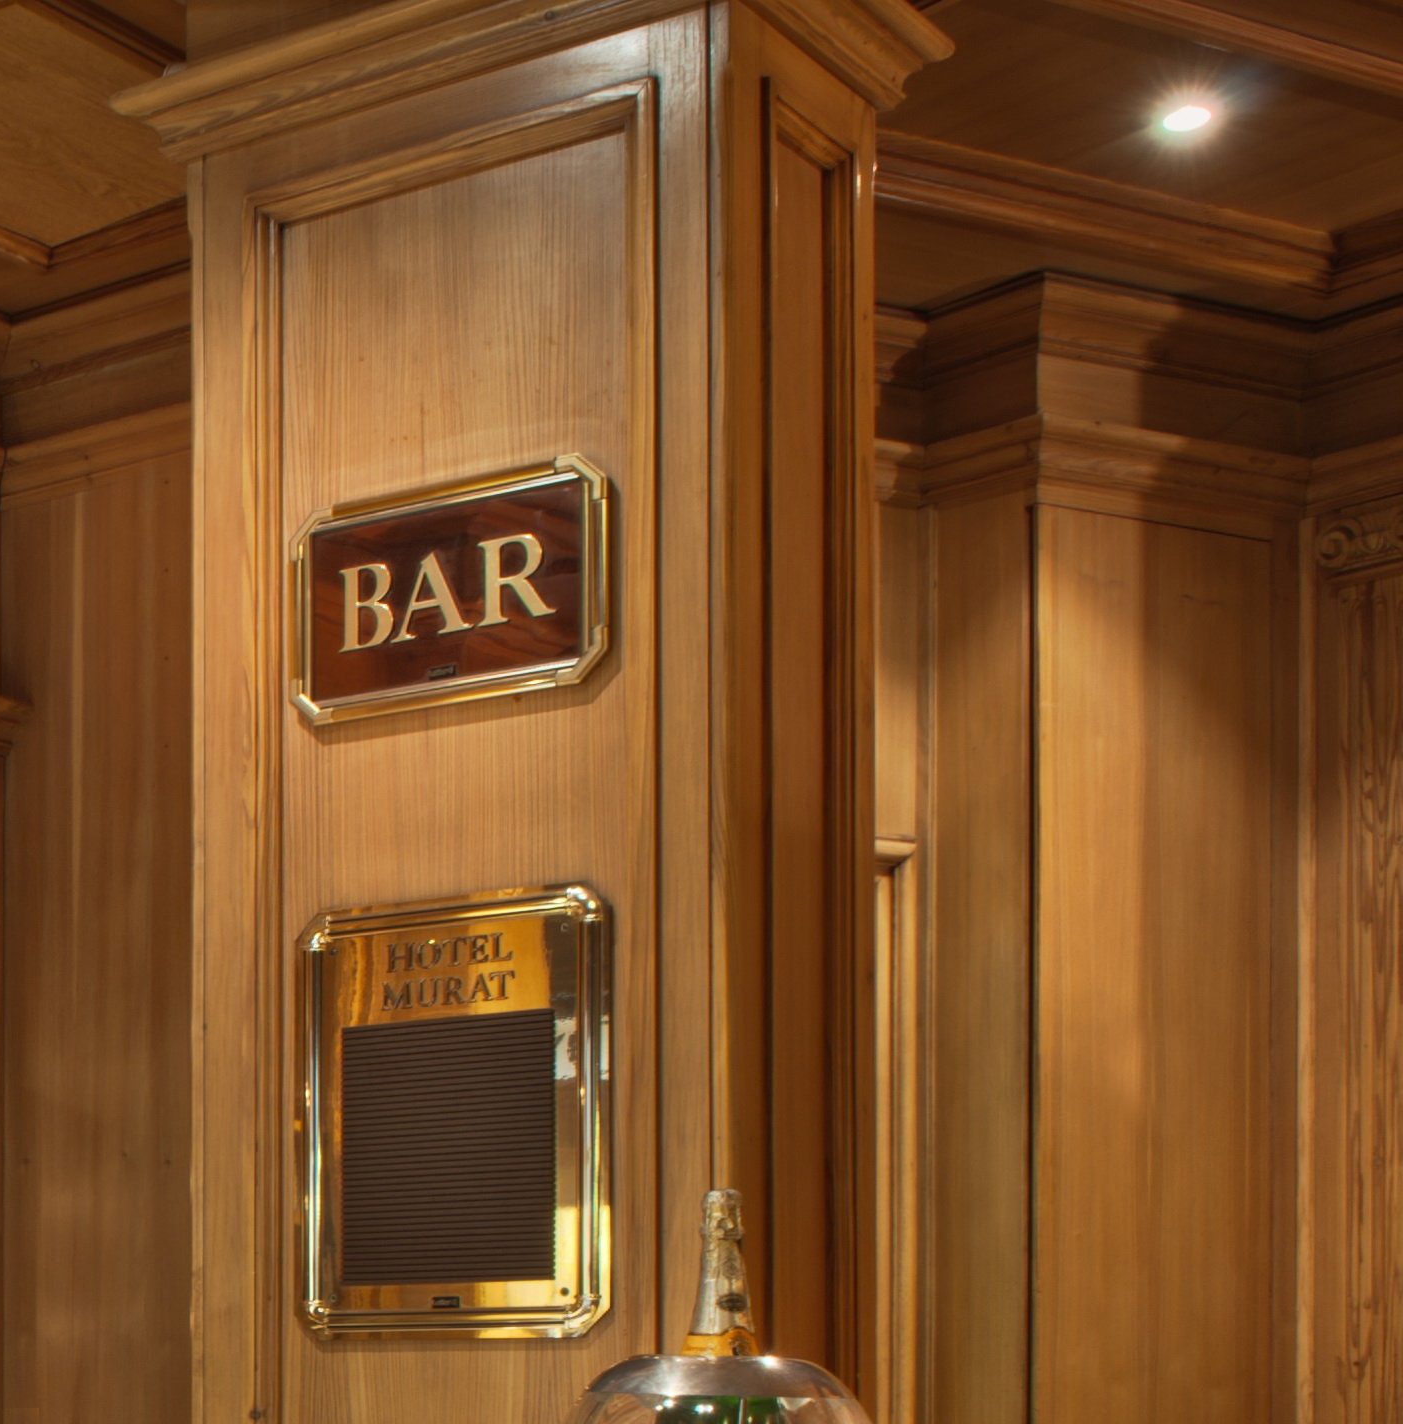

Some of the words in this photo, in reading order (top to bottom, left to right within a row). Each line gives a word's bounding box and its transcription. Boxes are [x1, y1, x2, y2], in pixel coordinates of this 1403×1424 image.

[338, 533, 557, 653] BAR
[386, 932, 514, 974] HOTEL
[381, 970, 516, 1012] MURAT
